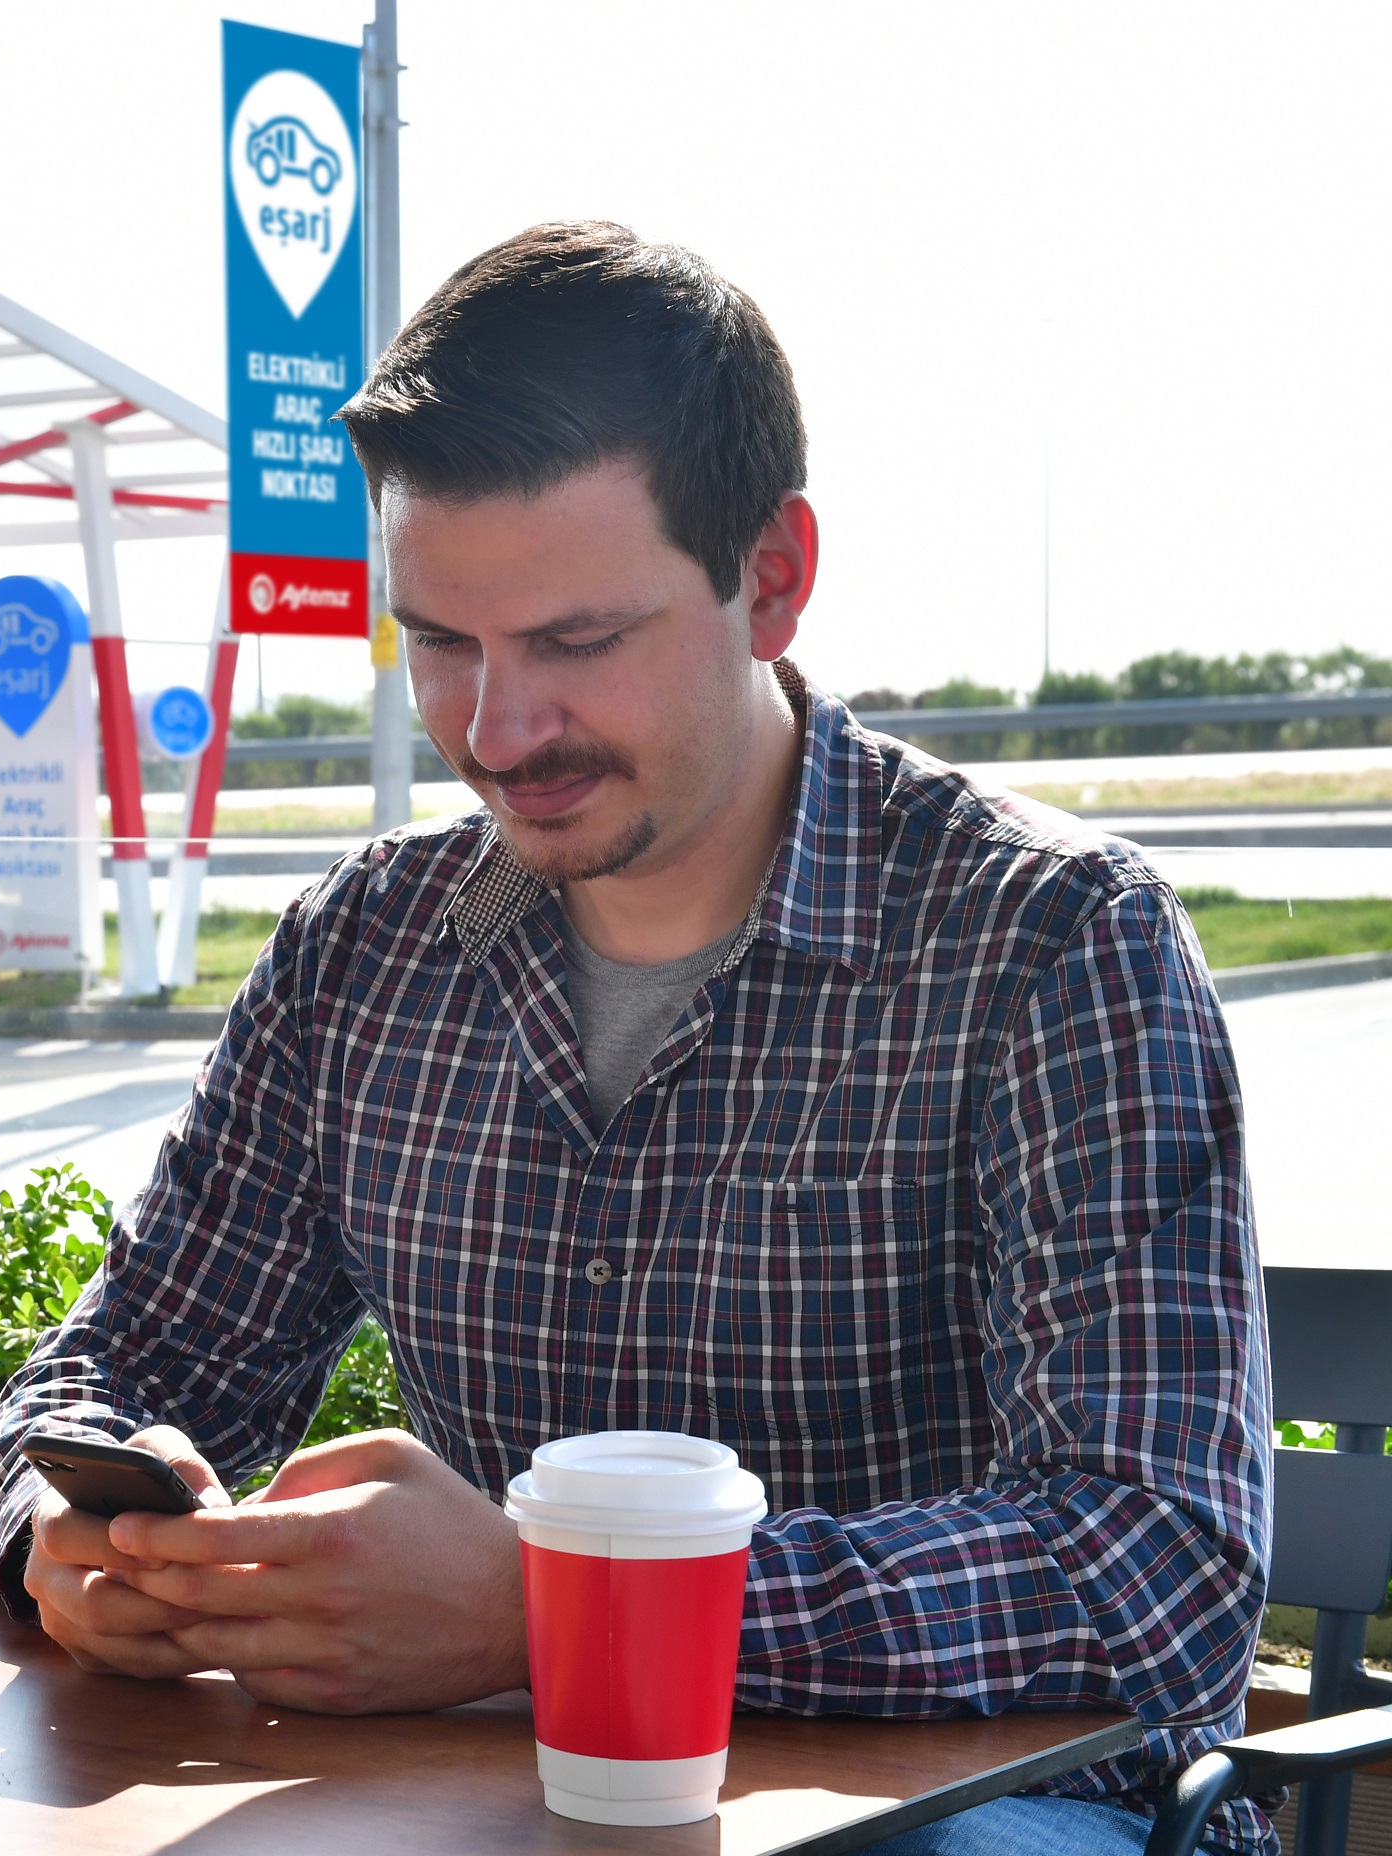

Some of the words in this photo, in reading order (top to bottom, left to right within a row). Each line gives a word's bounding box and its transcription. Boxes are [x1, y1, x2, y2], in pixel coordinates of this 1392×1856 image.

[259, 204, 331, 255] eşarj
[274, 394, 322, 432] ARAÇ
[253, 429, 296, 460] HIZLI
[299, 434, 344, 471] ŞARJ
[262, 469, 337, 503] NOKTASI
